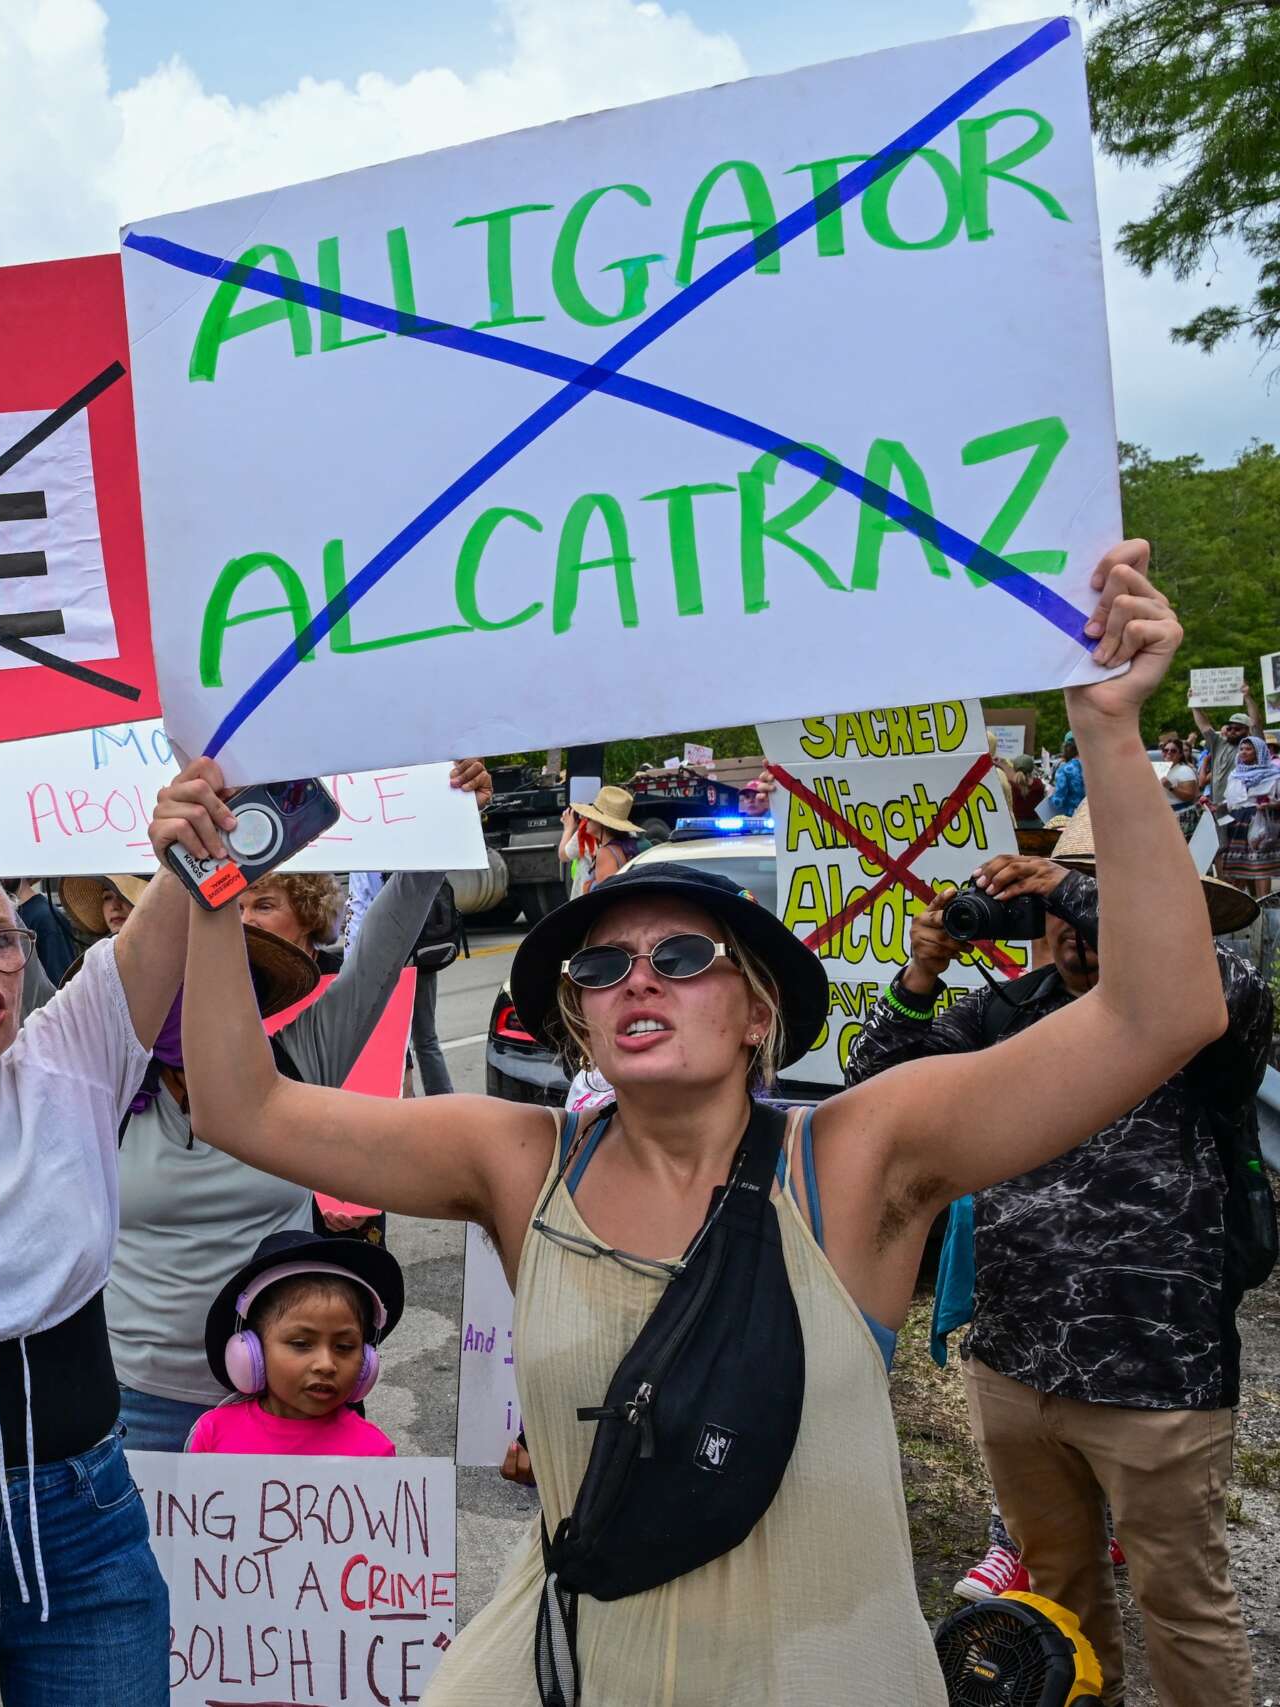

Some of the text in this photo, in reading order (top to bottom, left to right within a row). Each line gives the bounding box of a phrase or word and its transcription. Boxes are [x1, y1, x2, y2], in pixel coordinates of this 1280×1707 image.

[188, 107, 1071, 383] ALLIGATOR
[200, 416, 1070, 688] ALCATRAZ
[799, 700, 969, 760] SACRED
[785, 775, 999, 878] Alligator
[183, 853, 205, 880] KINGS
[463, 1323, 496, 1353] And
[136, 1477, 430, 1557] ING BROWN
[195, 1545, 283, 1600] NOT
[296, 1561, 329, 1612] A
